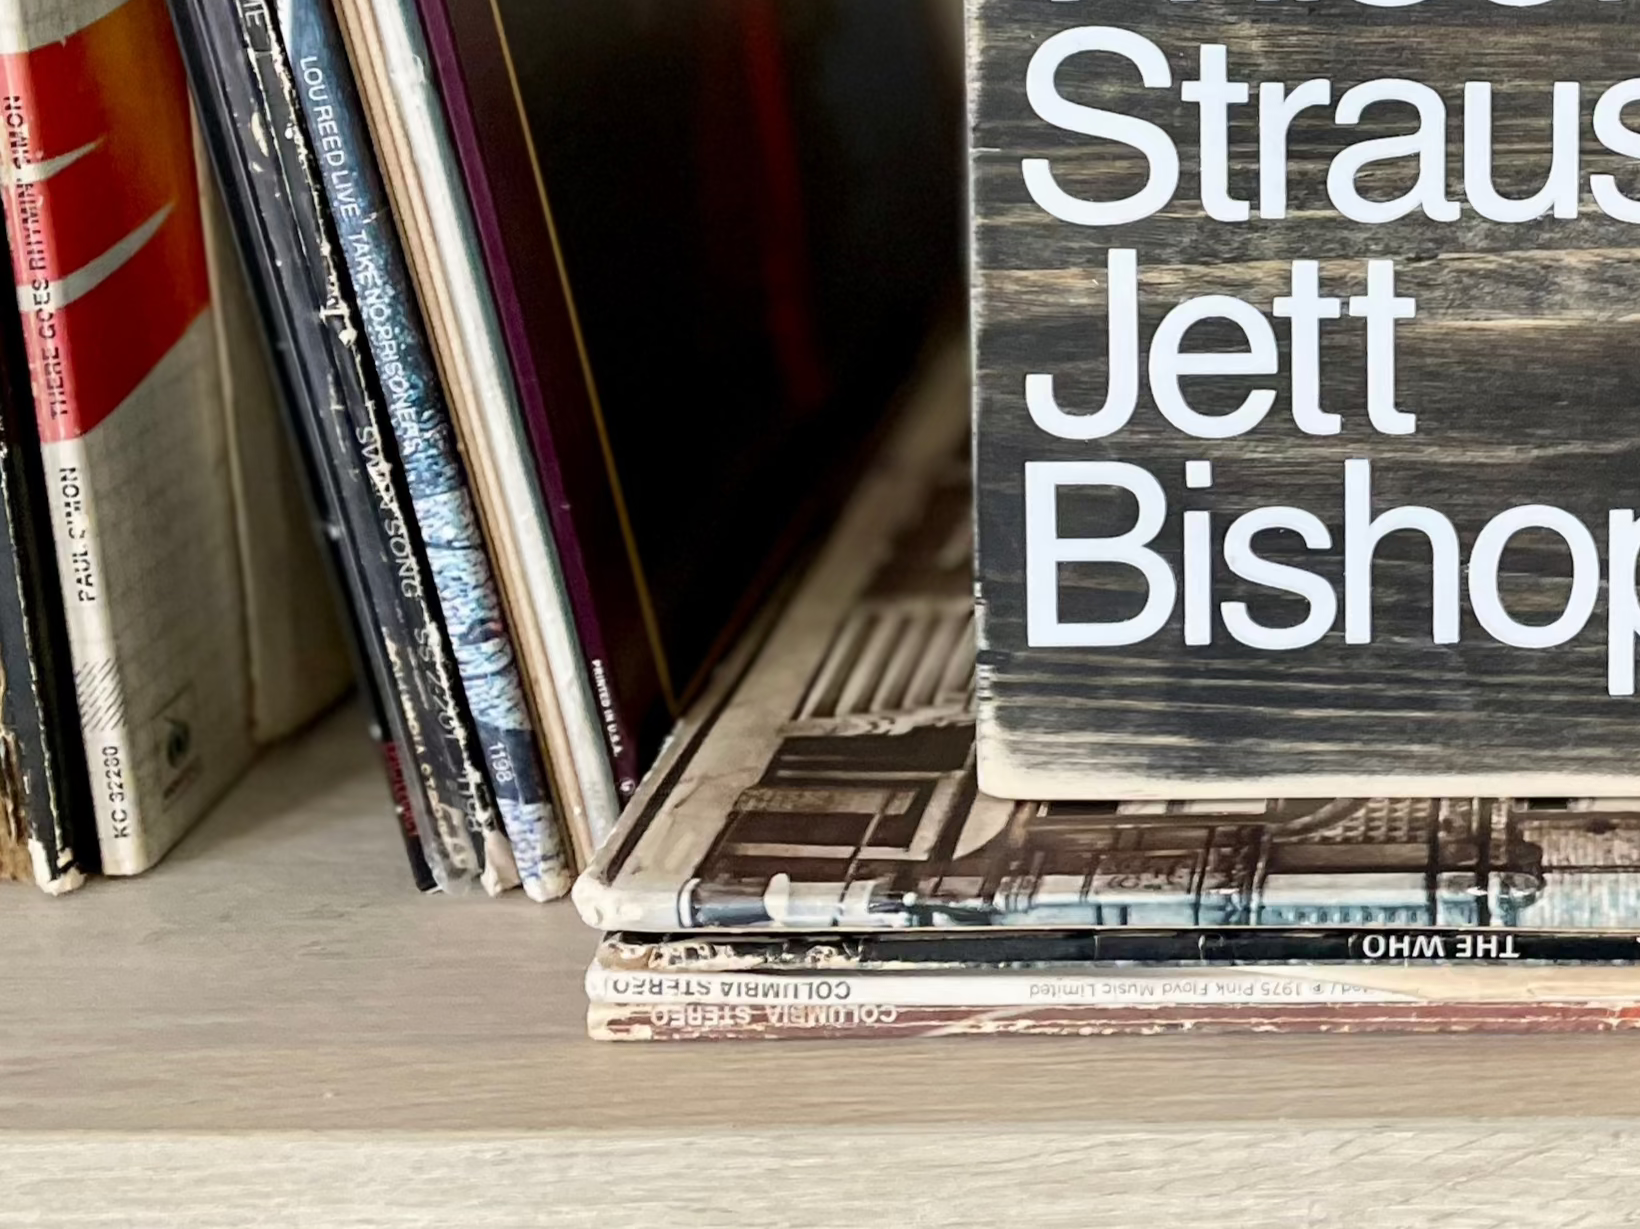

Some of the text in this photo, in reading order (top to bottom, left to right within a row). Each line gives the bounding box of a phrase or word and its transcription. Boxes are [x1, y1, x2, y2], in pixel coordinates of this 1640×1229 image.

[2, 94, 31, 169] SIMON
[298, 54, 424, 455] LOU REED LIVE TAKE NO PRISONERS
[30, 277, 57, 340] GOES
[1026, 249, 1415, 439] Jett
[40, 346, 70, 420] THERE
[58, 466, 96, 601] PAUL SMON
[382, 516, 421, 601] SONG
[413, 625, 437, 662] SS
[384, 639, 426, 755] OLUMBIA
[589, 658, 624, 757] PRINTED IN U.S.A.
[486, 740, 514, 784] 1198
[110, 808, 130, 839] KC
[1362, 934, 1520, 960] THE WHO
[611, 978, 851, 1001] COLUMBIA STEREO
[648, 1003, 898, 1027] COLUMBIA STEREO
[1029, 981, 1096, 999] Limited
[1102, 980, 1154, 998] Music
[1214, 980, 1254, 998] Pink
[1261, 981, 1302, 998] 1975
